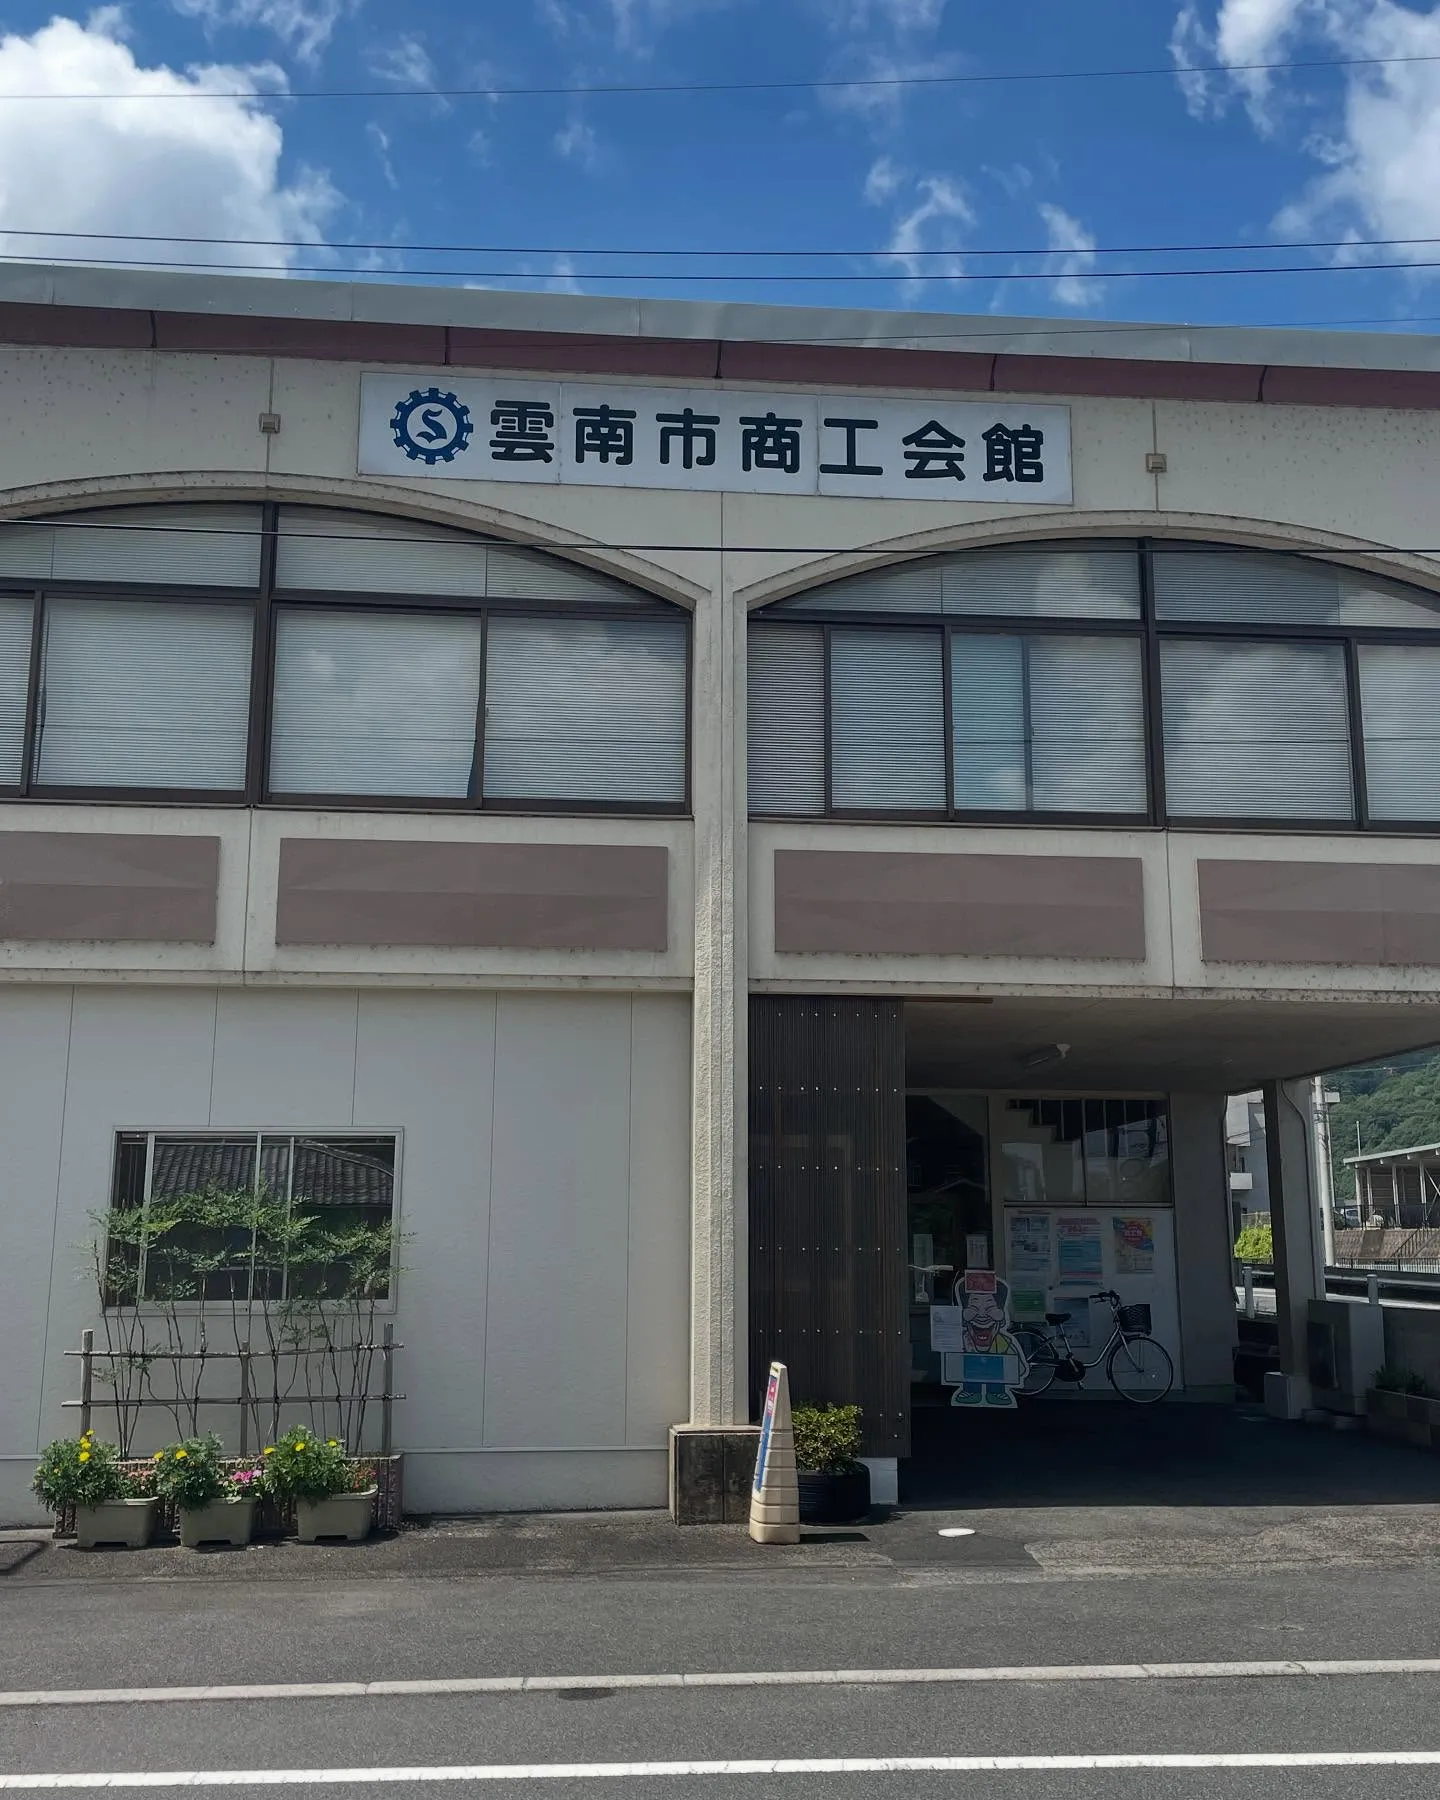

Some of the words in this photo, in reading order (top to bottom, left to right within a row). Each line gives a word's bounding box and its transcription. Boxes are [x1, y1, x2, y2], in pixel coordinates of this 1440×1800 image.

[415, 408, 448, 443] S
[488, 400, 1045, 483] 雲南市商工会館
